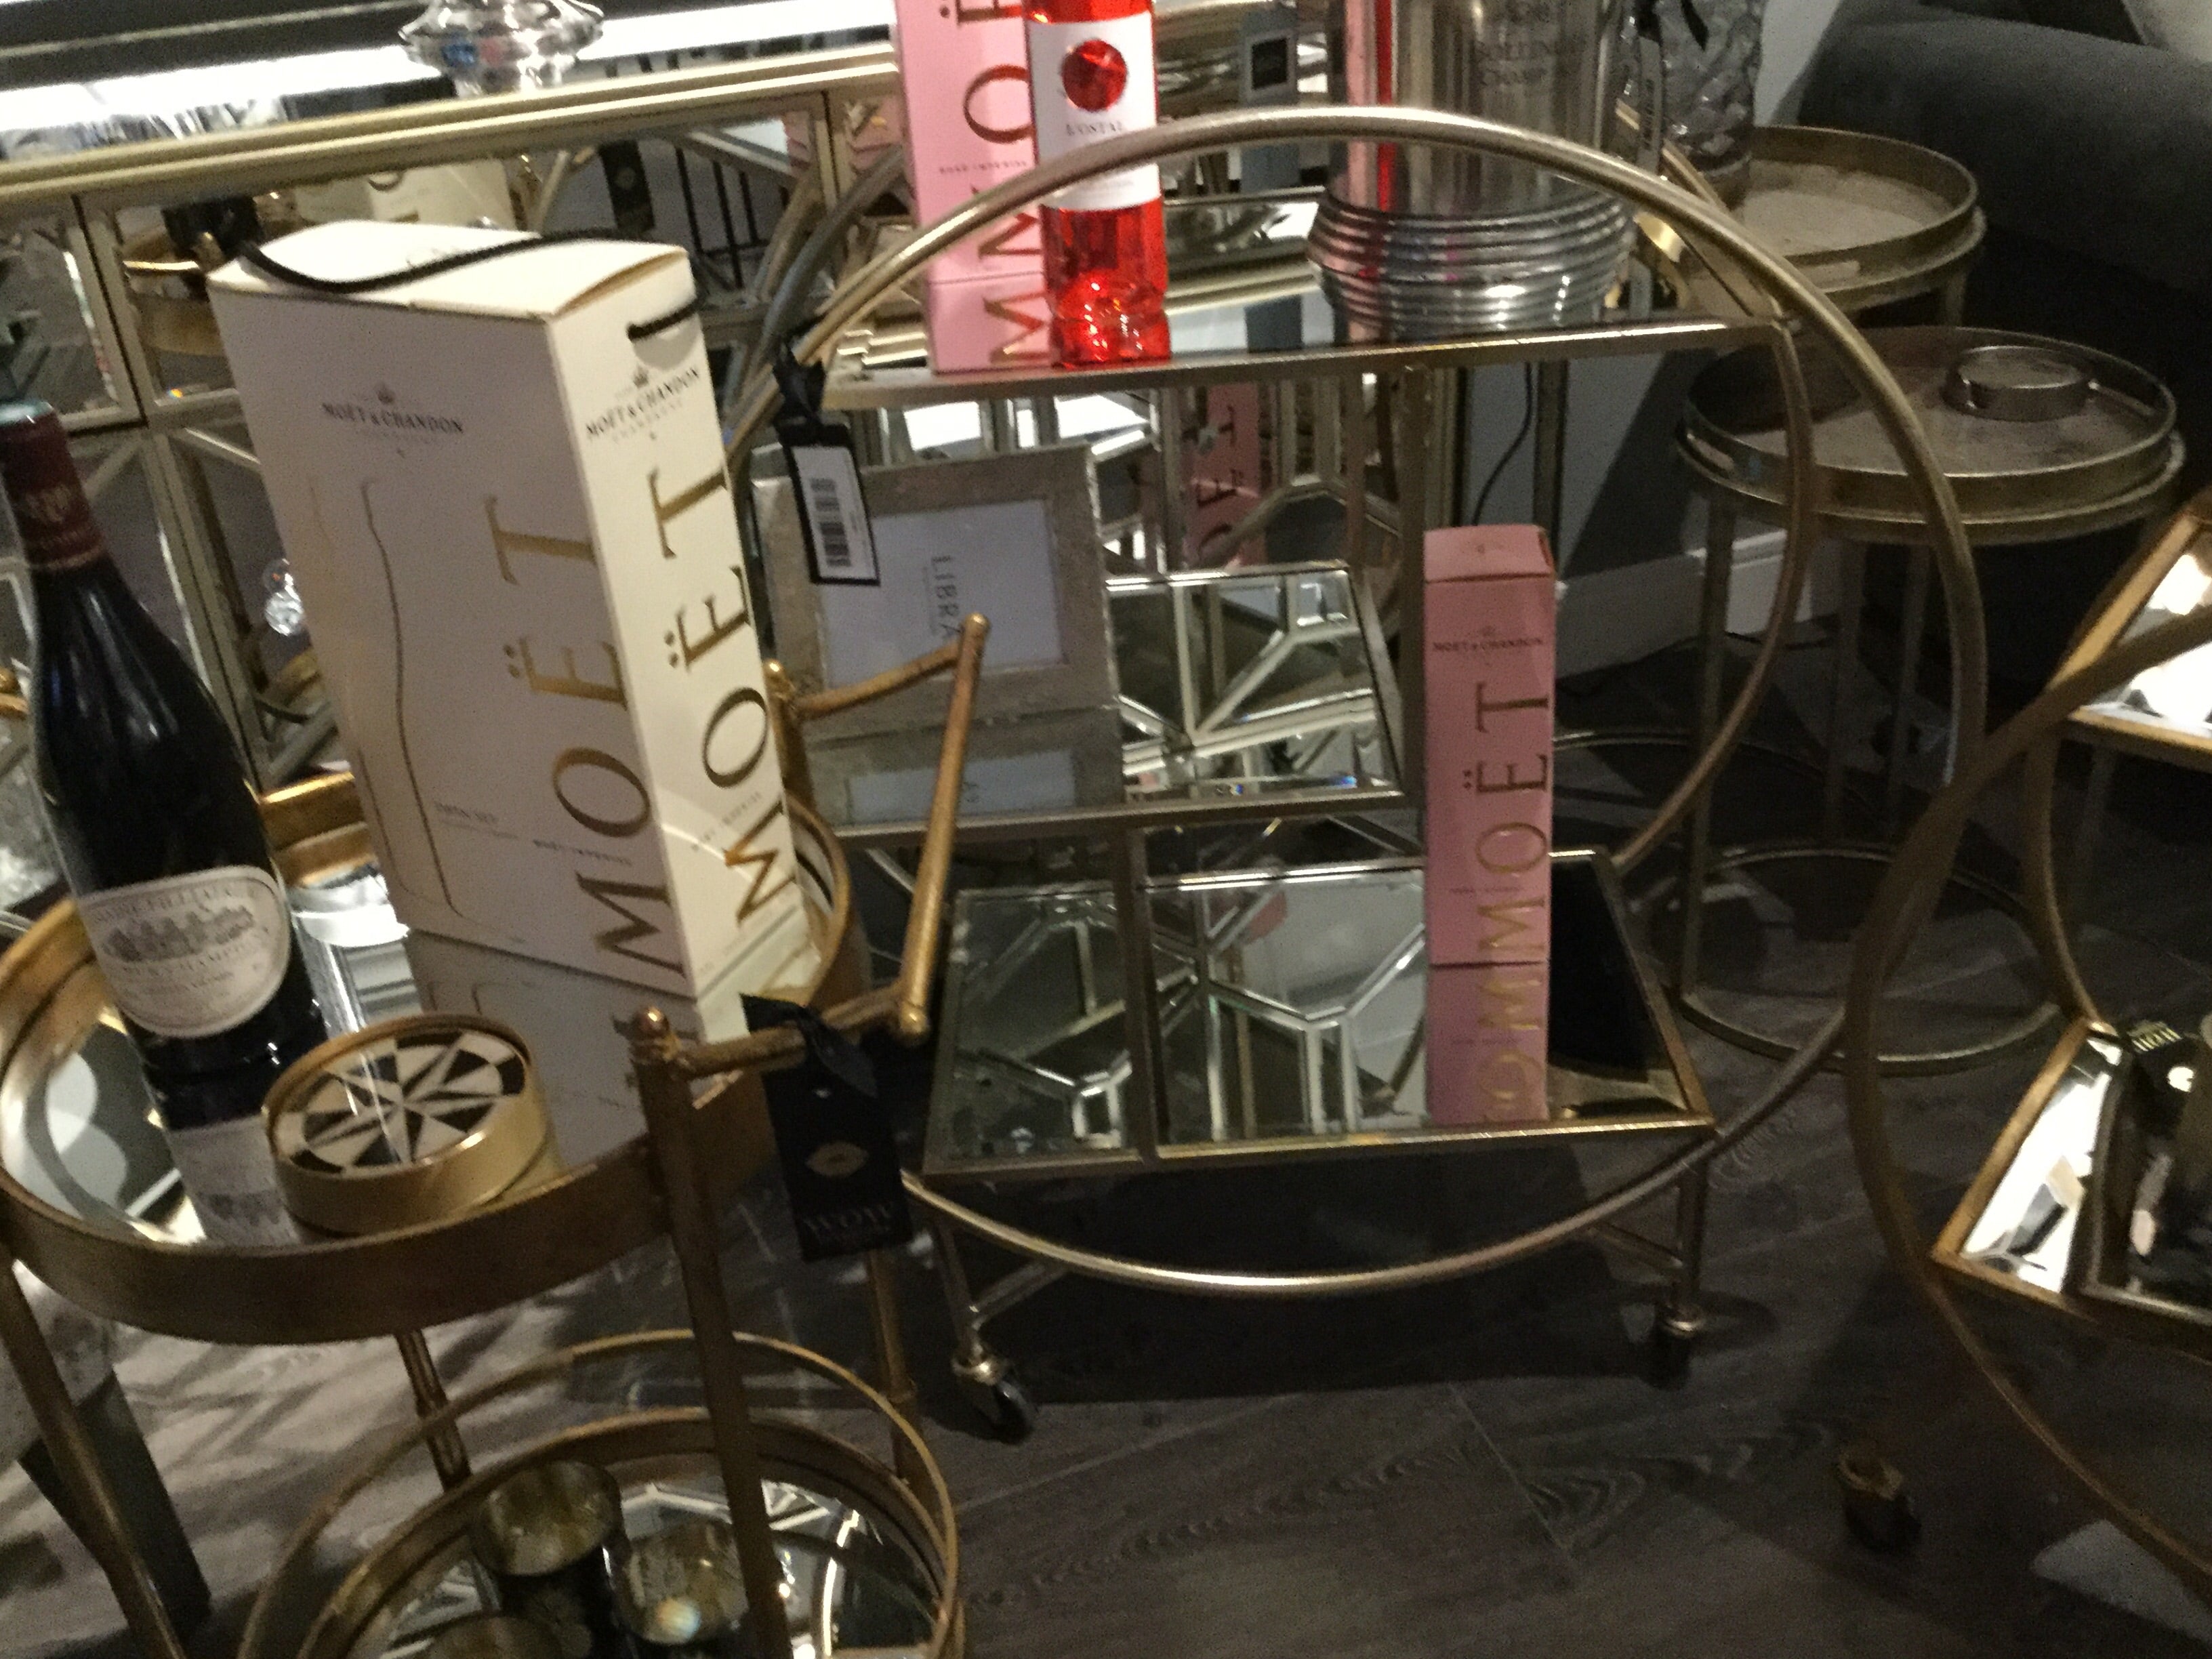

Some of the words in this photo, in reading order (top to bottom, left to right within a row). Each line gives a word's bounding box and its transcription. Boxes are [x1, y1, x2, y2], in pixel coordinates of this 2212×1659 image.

[484, 493, 687, 980] MOËT
[647, 464, 796, 925] MOËT
[1462, 681, 1549, 955] MOËT
